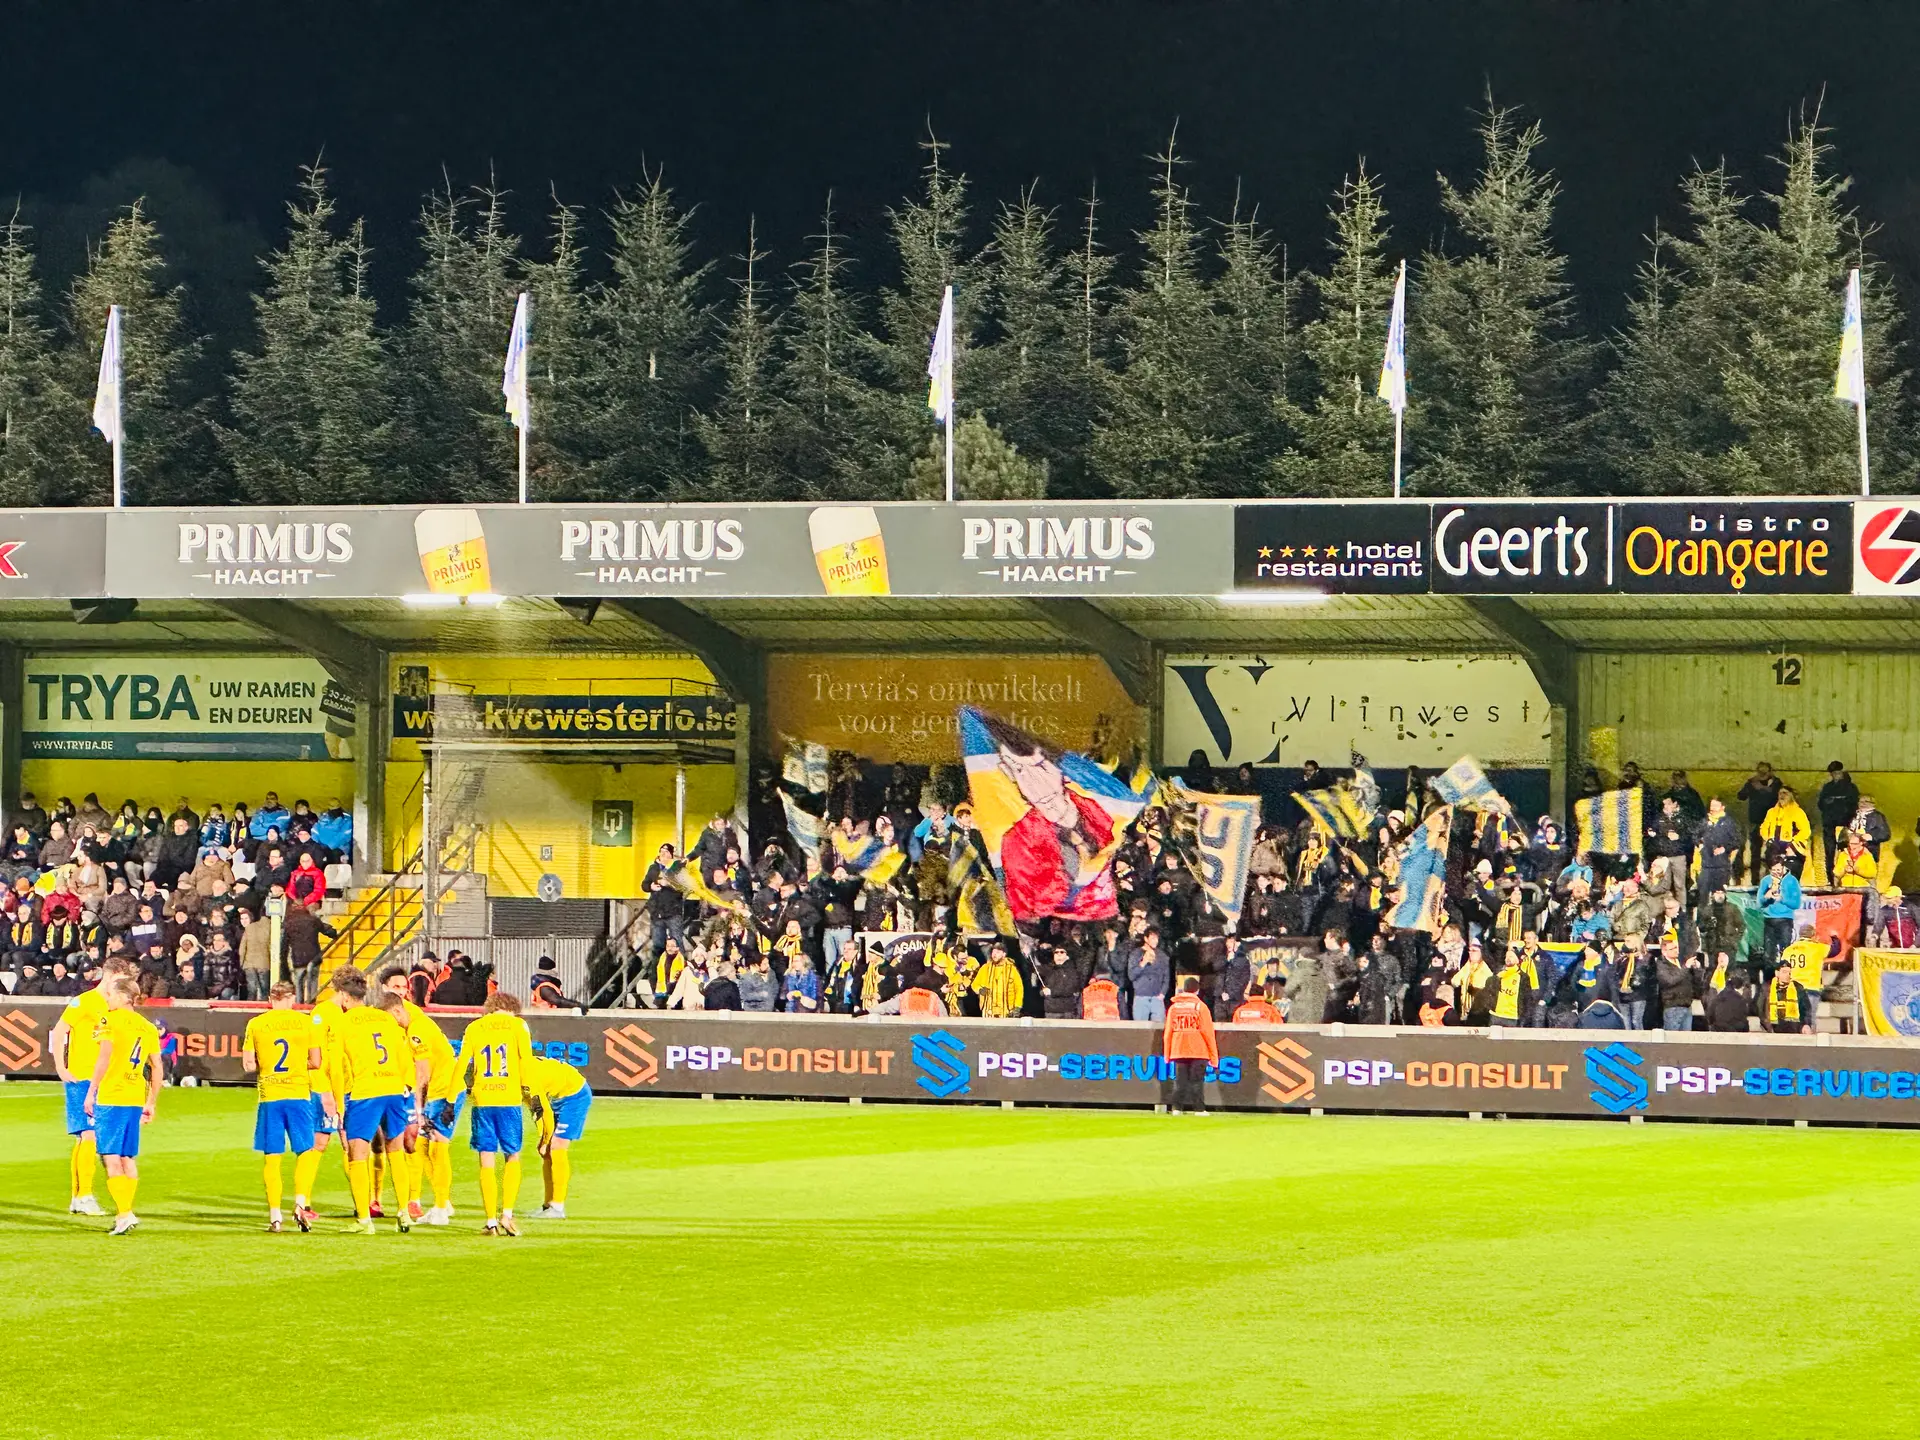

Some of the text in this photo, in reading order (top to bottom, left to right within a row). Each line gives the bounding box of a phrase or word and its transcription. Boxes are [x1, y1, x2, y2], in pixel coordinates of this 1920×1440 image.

[1690, 514, 1829, 532] bistro
[178, 523, 353, 563] PRIMUS
[560, 519, 745, 561] PRIMUS
[962, 517, 1155, 560] PRIMUS
[1346, 541, 1421, 559] hotel
[1435, 508, 1590, 576] Geerts
[432, 557, 482, 582] PRIMUS
[828, 555, 879, 580] PRIMUS
[1257, 560, 1423, 577] restaurant
[1625, 526, 1828, 589] Orangerie
[214, 569, 313, 585] HAACHT
[598, 566, 703, 583] HAACHT
[1003, 565, 1111, 582] HAACHT
[1772, 657, 1801, 685] 12
[27, 674, 200, 721] TRYBA
[209, 682, 316, 698] UW RAMEN
[808, 673, 919, 702] Tervia's
[209, 707, 313, 724] EN DEUREN
[1290, 695, 1530, 723] Vlinvest
[838, 713, 902, 734] voor
[32, 740, 114, 750] WWW.TRYBA.BE
[1790, 953, 1806, 970] 69
[129, 1036, 142, 1070] 4
[273, 1038, 290, 1073] 2
[372, 1032, 389, 1065] 5
[480, 1043, 509, 1078] 11
[665, 1045, 895, 1075] PSP-CONSULT
[978, 1051, 1242, 1084] PSP-SERVIS
[1323, 1059, 1569, 1090] PSP-CONSULT
[1656, 1065, 1920, 1100] PSP-SERVICE
